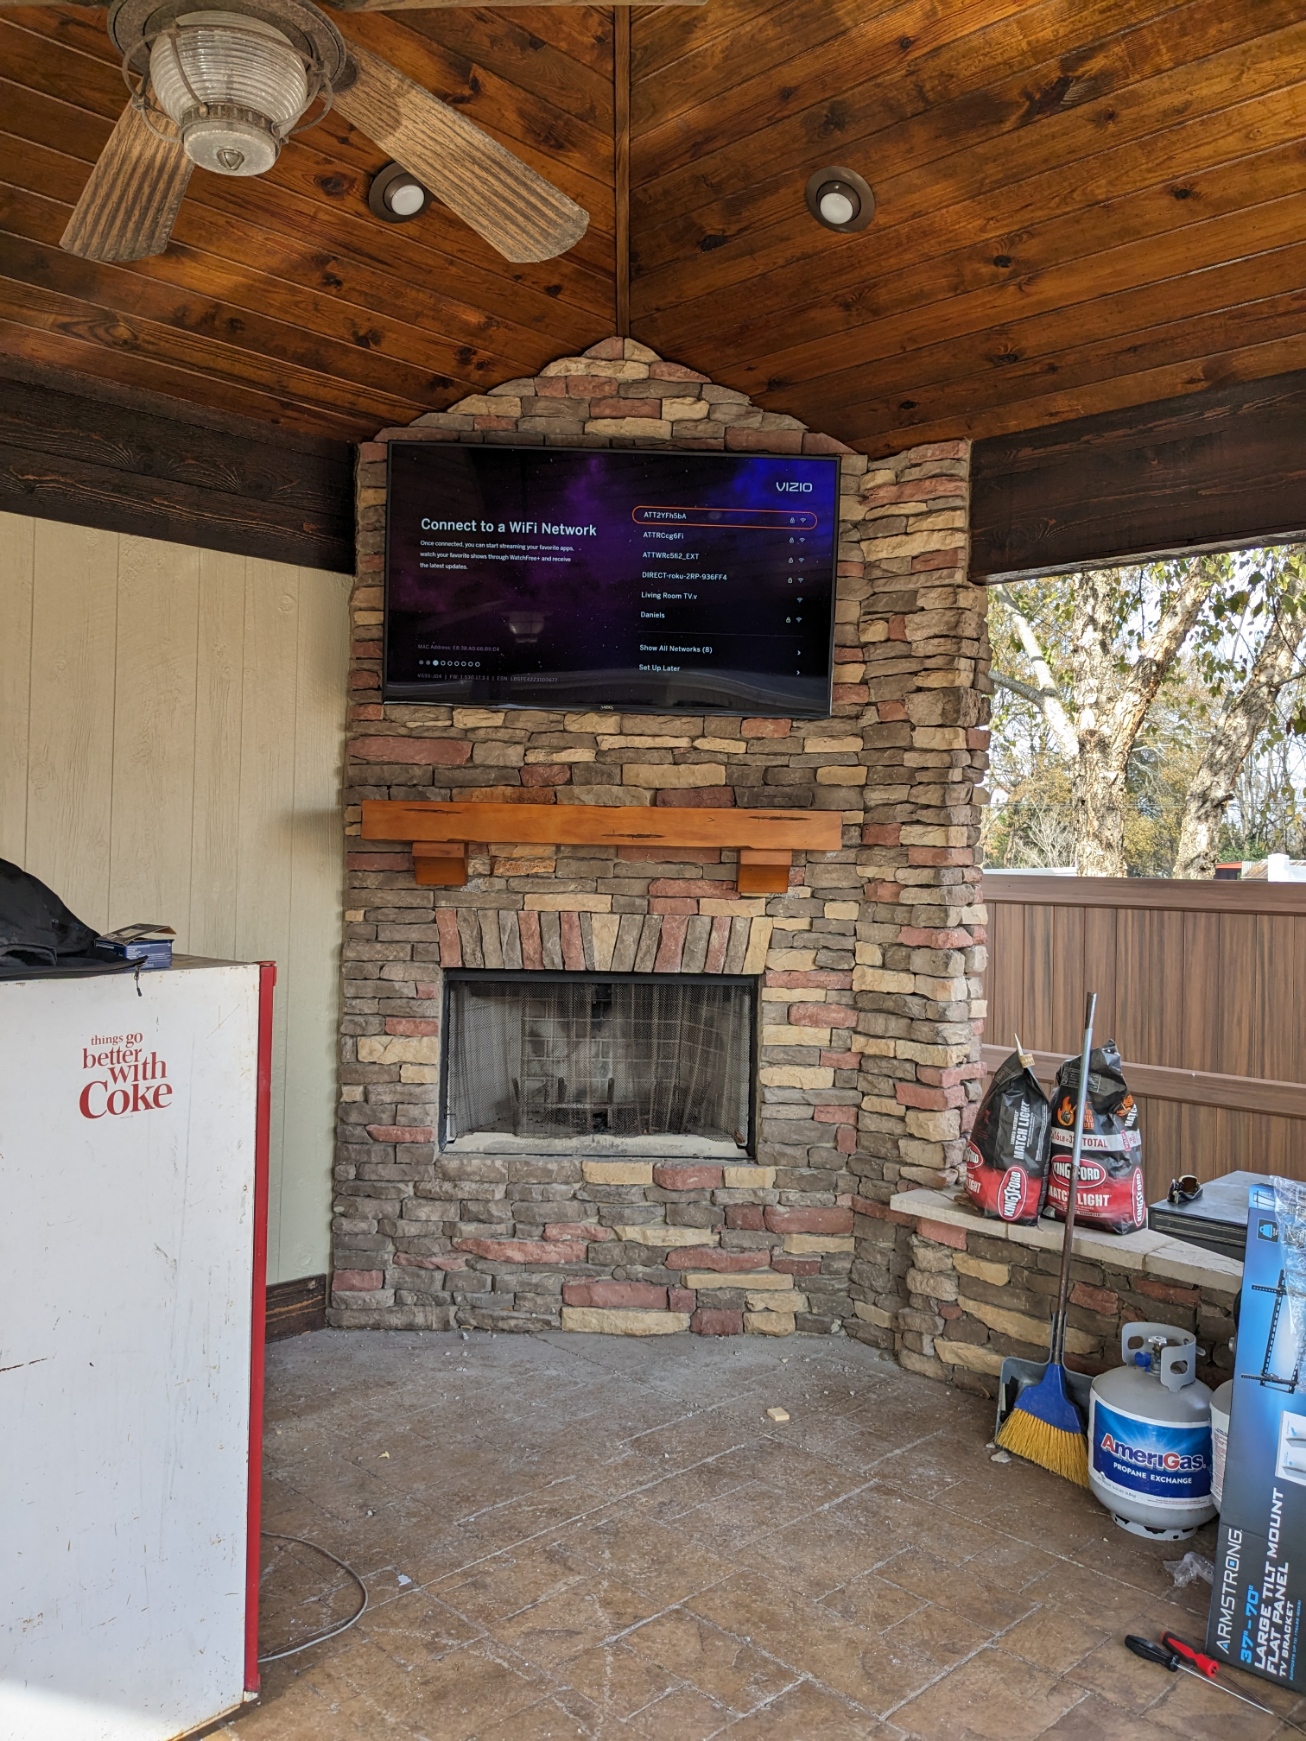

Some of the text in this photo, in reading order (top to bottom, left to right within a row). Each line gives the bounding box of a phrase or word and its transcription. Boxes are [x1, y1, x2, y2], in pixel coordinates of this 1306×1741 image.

[776, 482, 813, 492] VIZIO
[421, 518, 597, 536] Connect to a WiFi Network
[449, 551, 470, 559] favorite
[488, 553, 509, 561] through
[500, 543, 526, 551] streaming
[641, 591, 661, 600] Living
[662, 592, 682, 600] Room
[640, 611, 665, 619] Daniels
[669, 645, 701, 653] Networks
[702, 646, 713, 654] (8)
[651, 664, 661, 673] Up
[662, 664, 681, 672] Later
[91, 1032, 143, 1047] things go
[82, 1046, 143, 1069] better
[107, 1052, 167, 1085] with
[79, 1080, 173, 1119] Coke
[1018, 1100, 1031, 1127] LIGHT
[1125, 1103, 1138, 1126] MATC
[1013, 1128, 1028, 1160] MATCH
[1082, 1137, 1108, 1148] TOTAL
[1004, 1171, 1022, 1217] KINGSFORD
[1048, 1185, 1110, 1207] MATC LIGHT
[1135, 1173, 1144, 1222] KINGSFORD
[1101, 1433, 1206, 1471] AmeriGas
[1113, 1461, 1193, 1484] PROPANE EXCHANGE
[1254, 1487, 1284, 1670] LARGE TILT MOUNT
[1216, 1528, 1242, 1655] ARMSTRONG
[1267, 1562, 1289, 1675] FLAT PANEL
[1279, 1600, 1294, 1677] TV BRACKET
